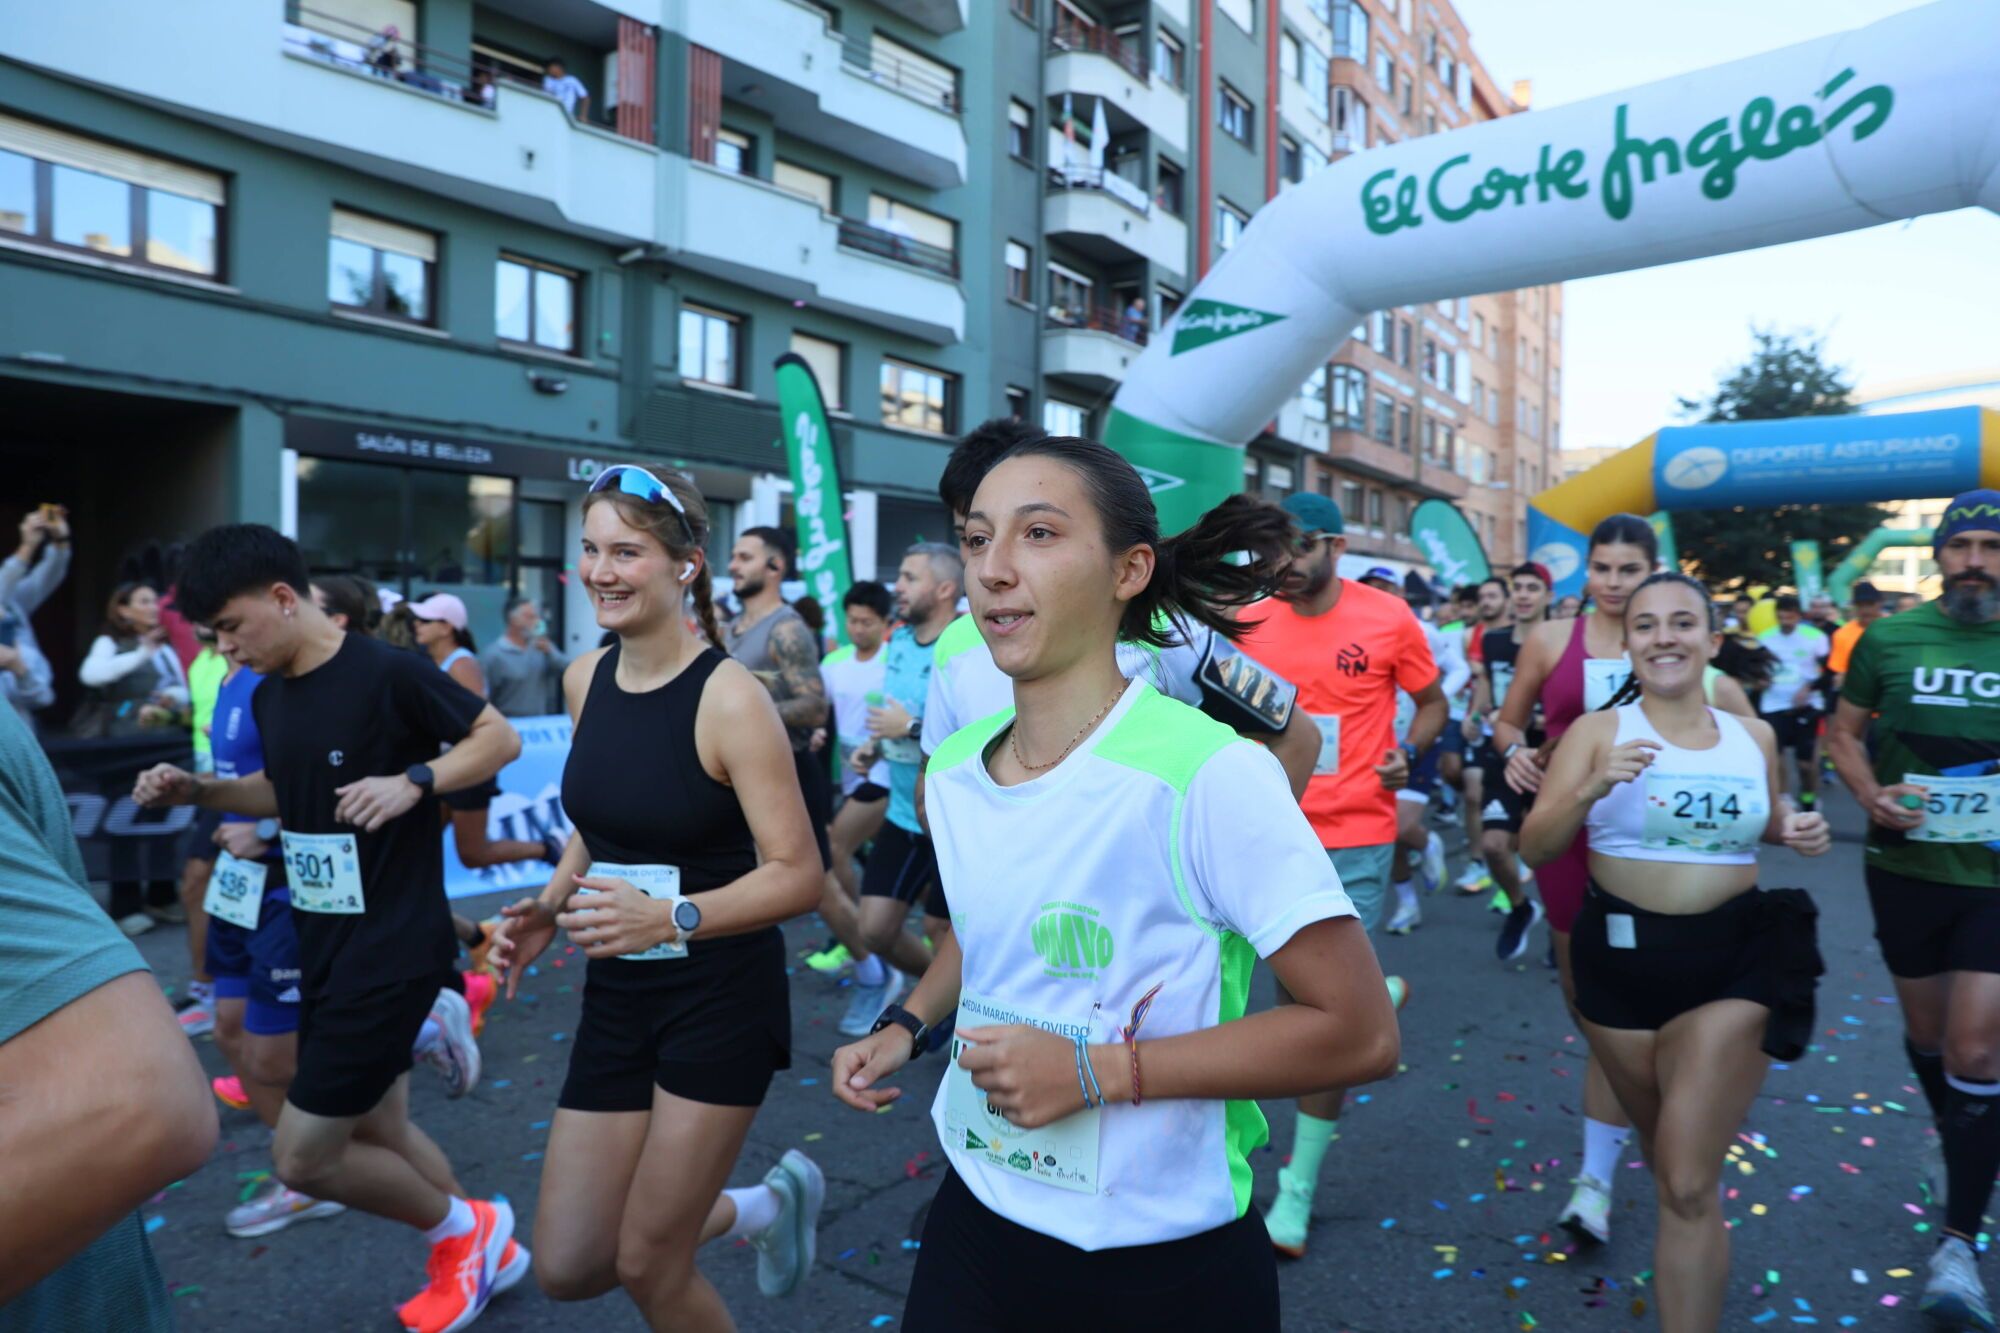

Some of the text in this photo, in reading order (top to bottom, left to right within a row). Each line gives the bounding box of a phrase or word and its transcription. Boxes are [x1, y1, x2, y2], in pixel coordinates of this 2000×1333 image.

[1361, 67, 1895, 236] El Corte Inglés
[356, 432, 492, 464] SALÓN DE BELLEZA
[1731, 433, 1960, 466] DEPORTE ASTURIANO
[1673, 790, 1743, 821] 214
[1926, 792, 1990, 816] 572
[295, 851, 335, 880] 501
[219, 870, 249, 897] 436
[962, 997, 1091, 1039] MEDIA MARATÓN DE OVIEDO
